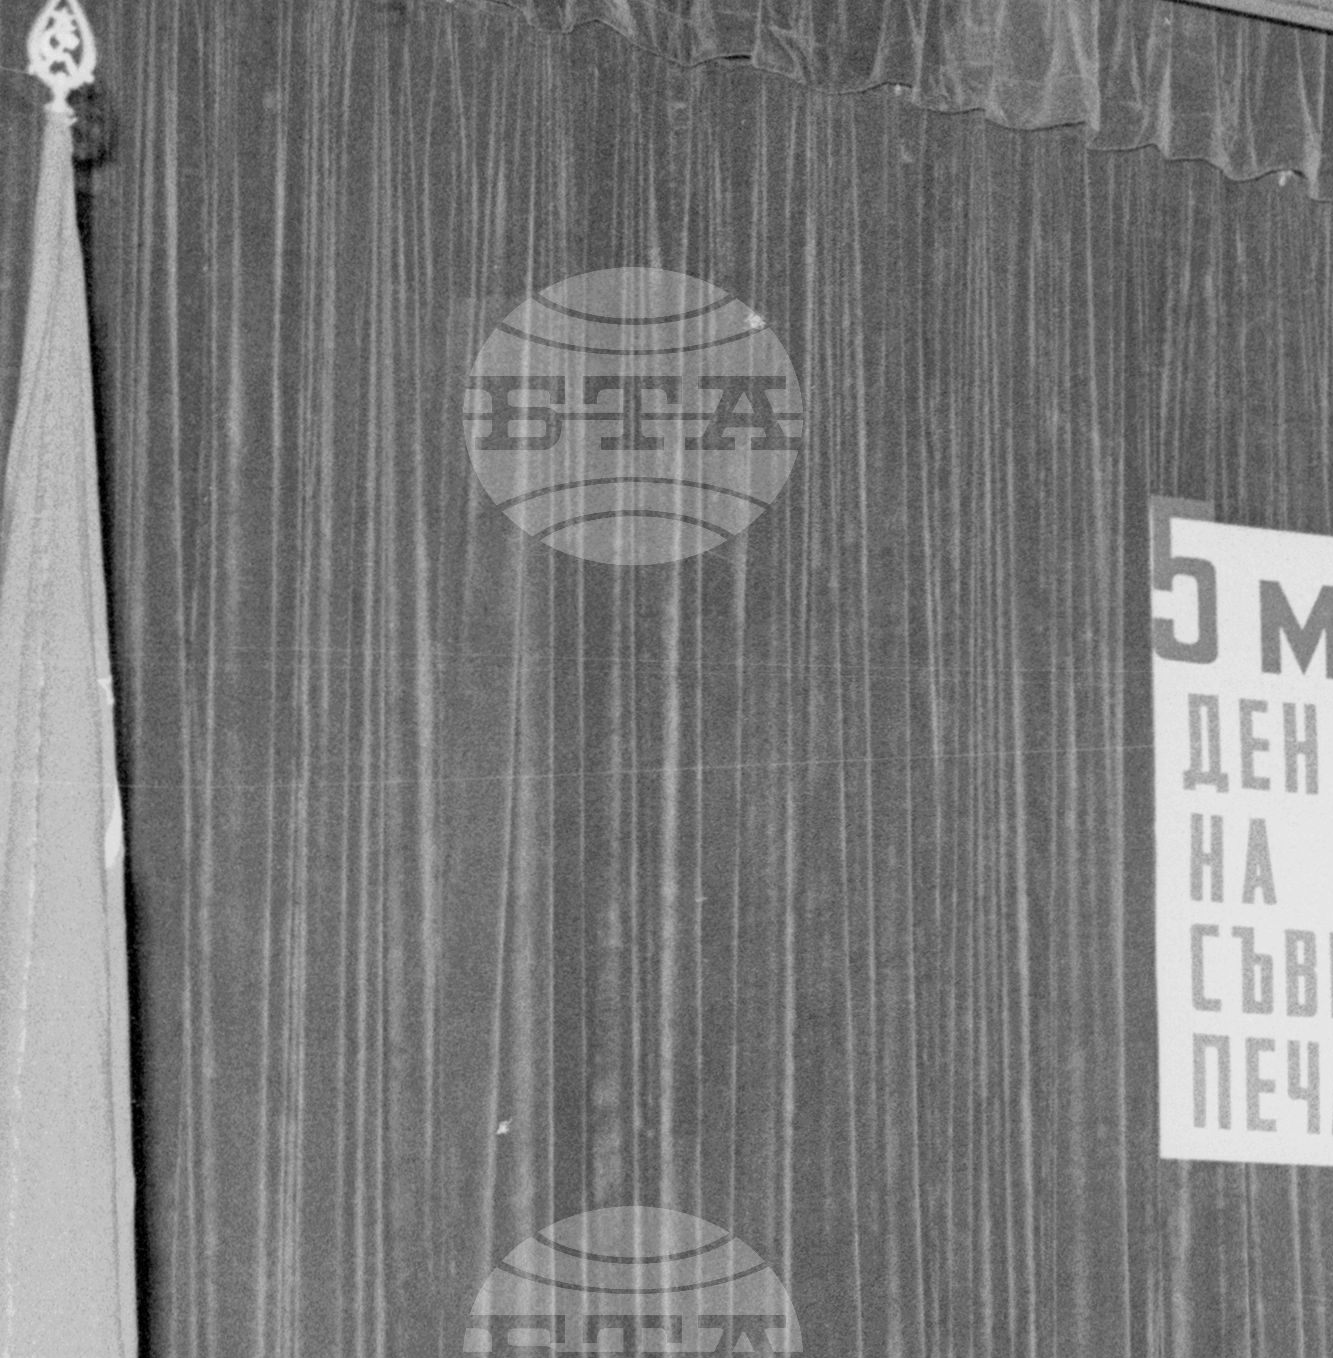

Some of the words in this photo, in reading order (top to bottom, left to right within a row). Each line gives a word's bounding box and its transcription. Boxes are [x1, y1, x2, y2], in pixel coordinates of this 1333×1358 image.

[1149, 494, 1219, 664] 5
[1182, 693, 1319, 795] ДЕН
[1190, 813, 1277, 905] НА
